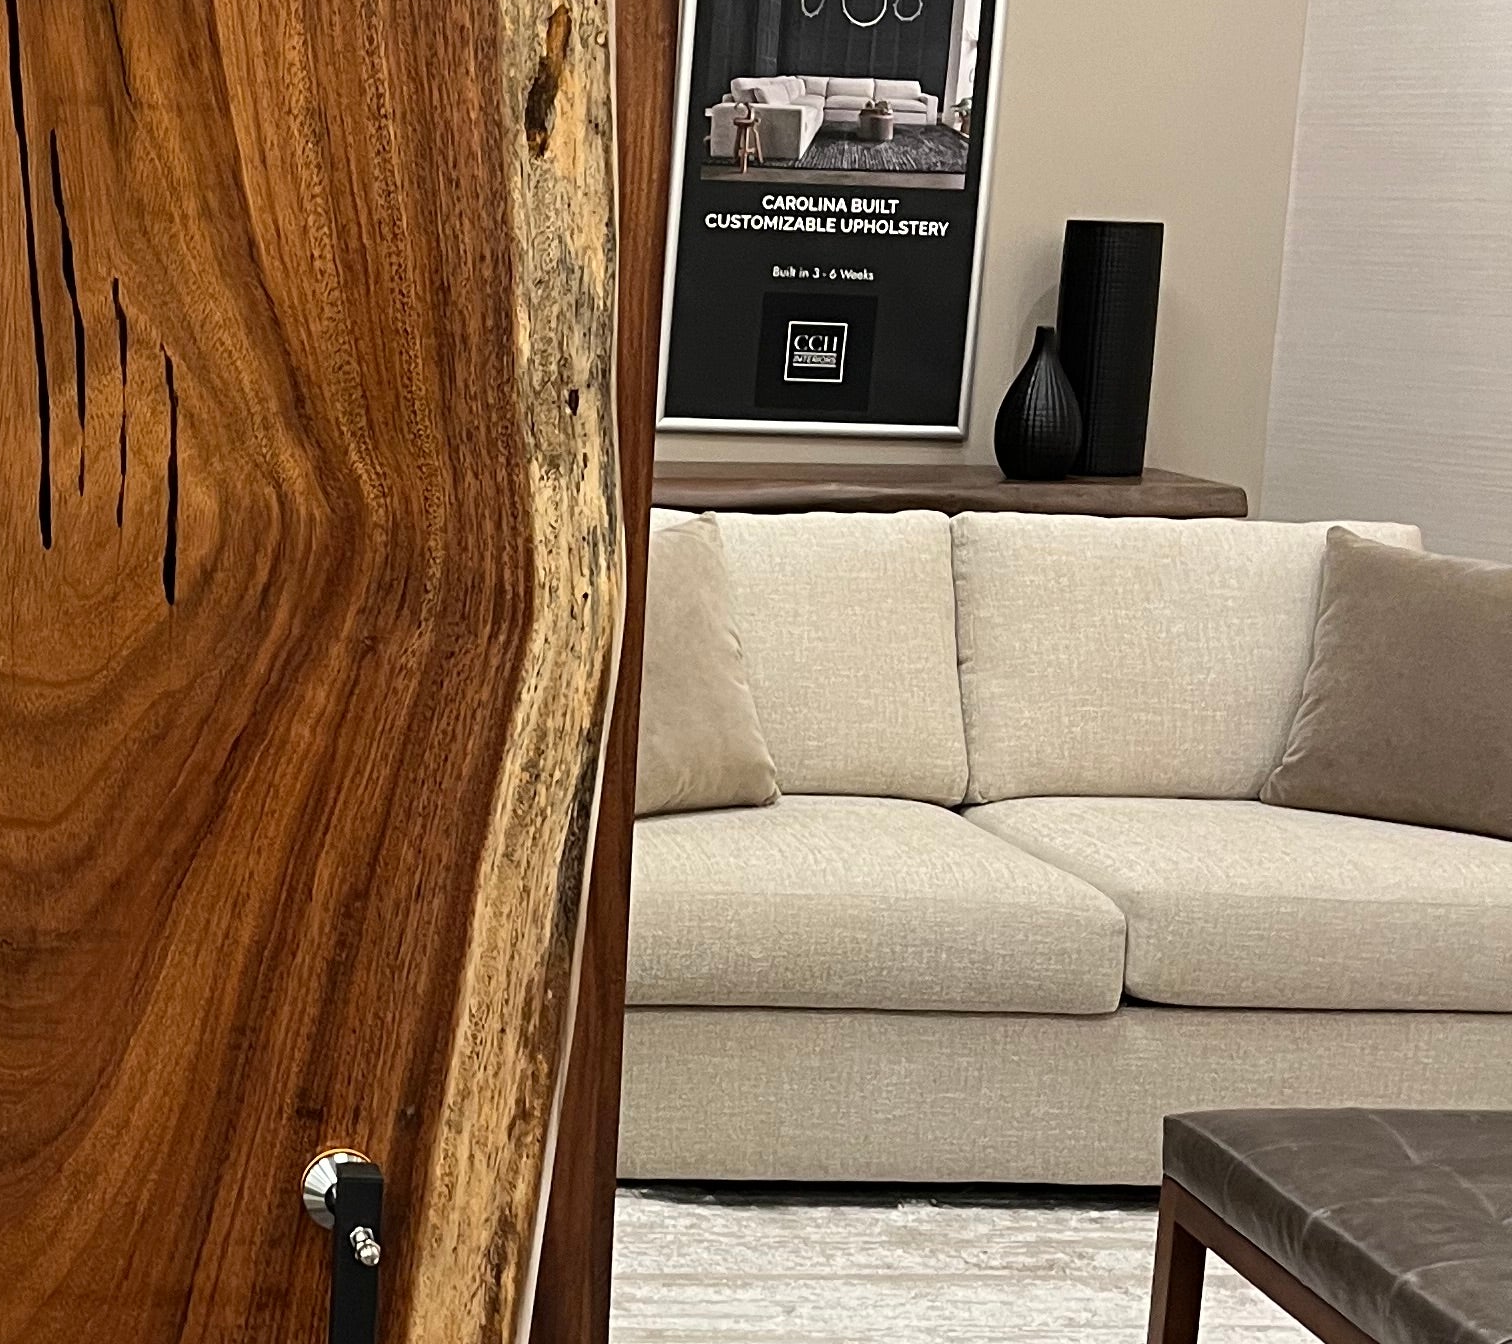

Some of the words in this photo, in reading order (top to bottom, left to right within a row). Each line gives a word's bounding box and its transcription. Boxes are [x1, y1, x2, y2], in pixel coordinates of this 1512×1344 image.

[762, 194, 848, 213] CAROLINA
[850, 198, 900, 215] BUILT
[704, 213, 837, 233] CUSTOMIZABLE
[840, 218, 950, 237] UPHOLSTERY
[798, 266, 810, 279] in
[812, 267, 820, 279] 3
[829, 268, 837, 280] 6
[839, 268, 874, 281] Weeks
